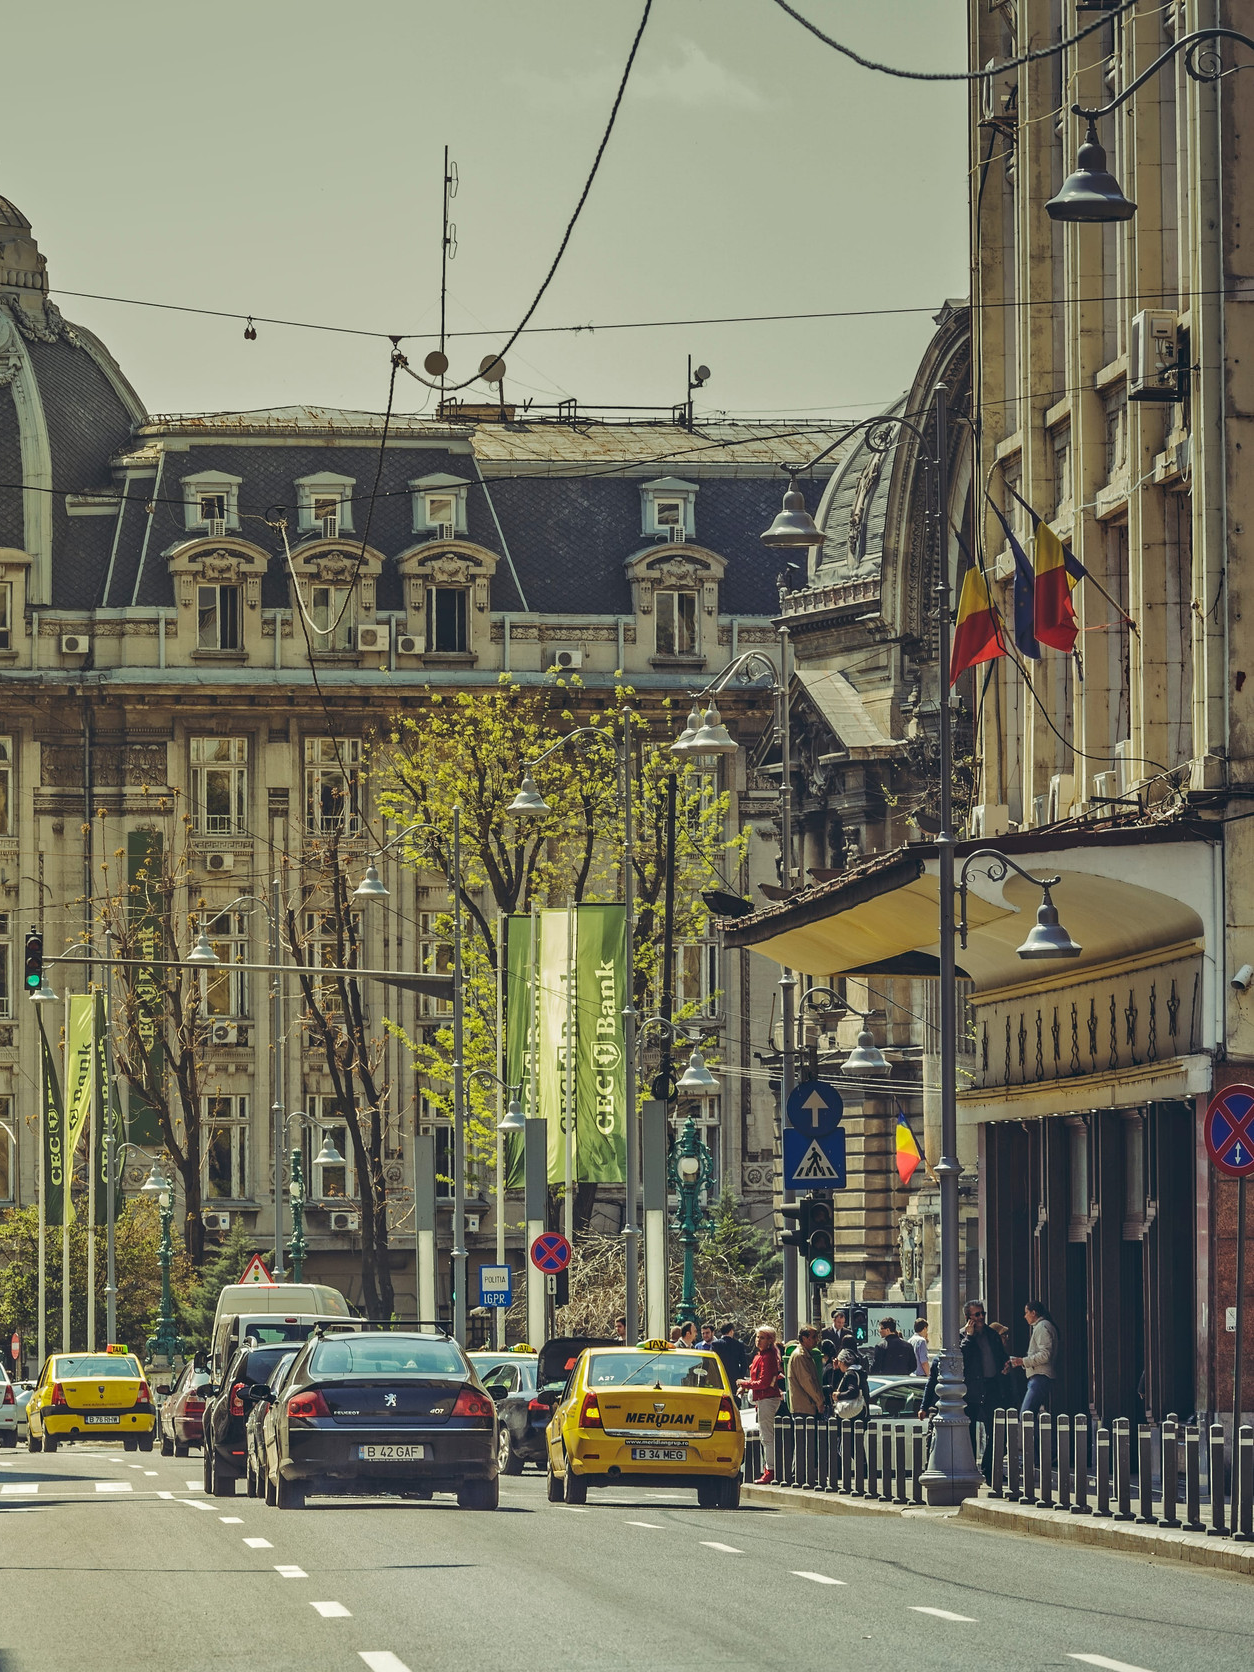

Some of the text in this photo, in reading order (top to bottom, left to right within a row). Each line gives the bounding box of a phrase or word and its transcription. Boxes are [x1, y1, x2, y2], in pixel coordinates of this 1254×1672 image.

[595, 959, 615, 1135] CEC Bank
[49, 1137, 62, 1186] CEC
[648, 1339, 667, 1349] TAXI
[625, 1412, 695, 1425] MERIDIAN
[367, 1446, 419, 1458] B 42 GAF
[639, 1449, 683, 1459] B 34 MEG
